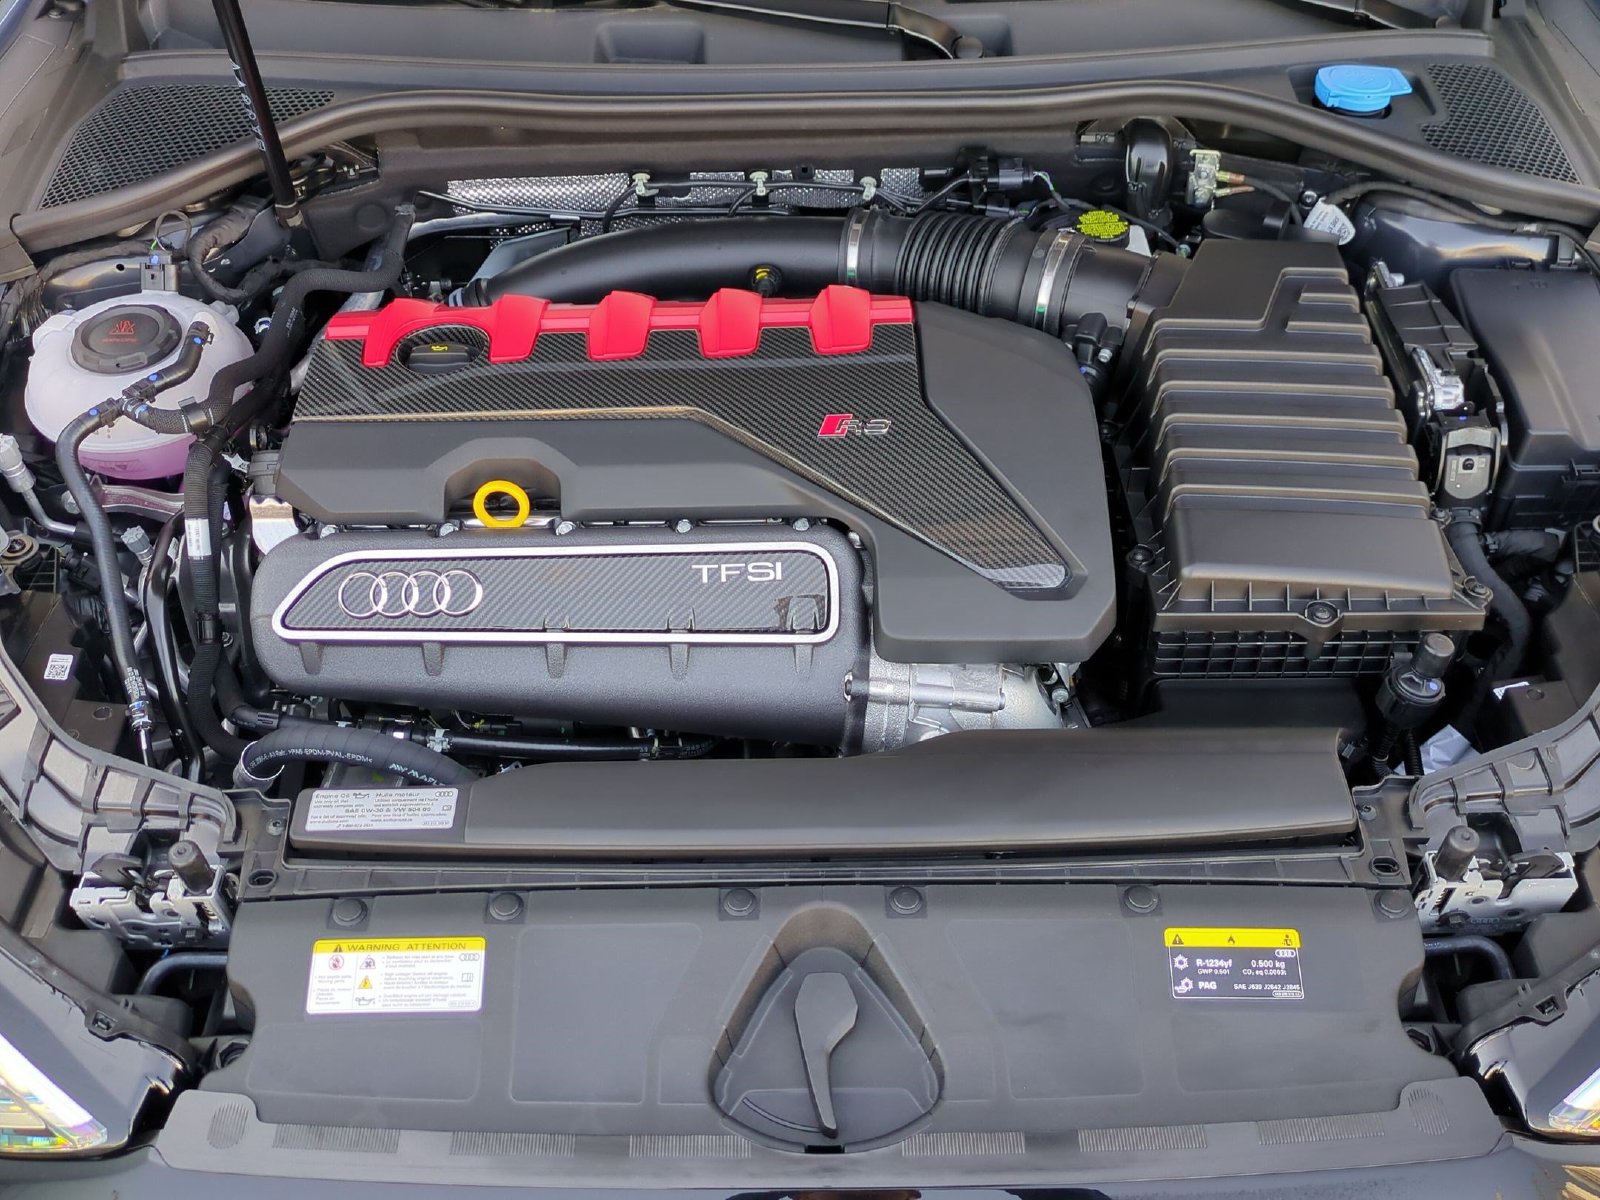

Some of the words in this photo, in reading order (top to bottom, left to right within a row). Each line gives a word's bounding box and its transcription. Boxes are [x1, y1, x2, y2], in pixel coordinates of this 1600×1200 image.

[691, 562, 782, 584] TFSI
[347, 943, 400, 952] WARNING
[406, 942, 467, 951] ATTENTION
[1251, 959, 1274, 968] 0.500
[1275, 959, 1286, 970] kg
[1198, 981, 1217, 990] PAG
